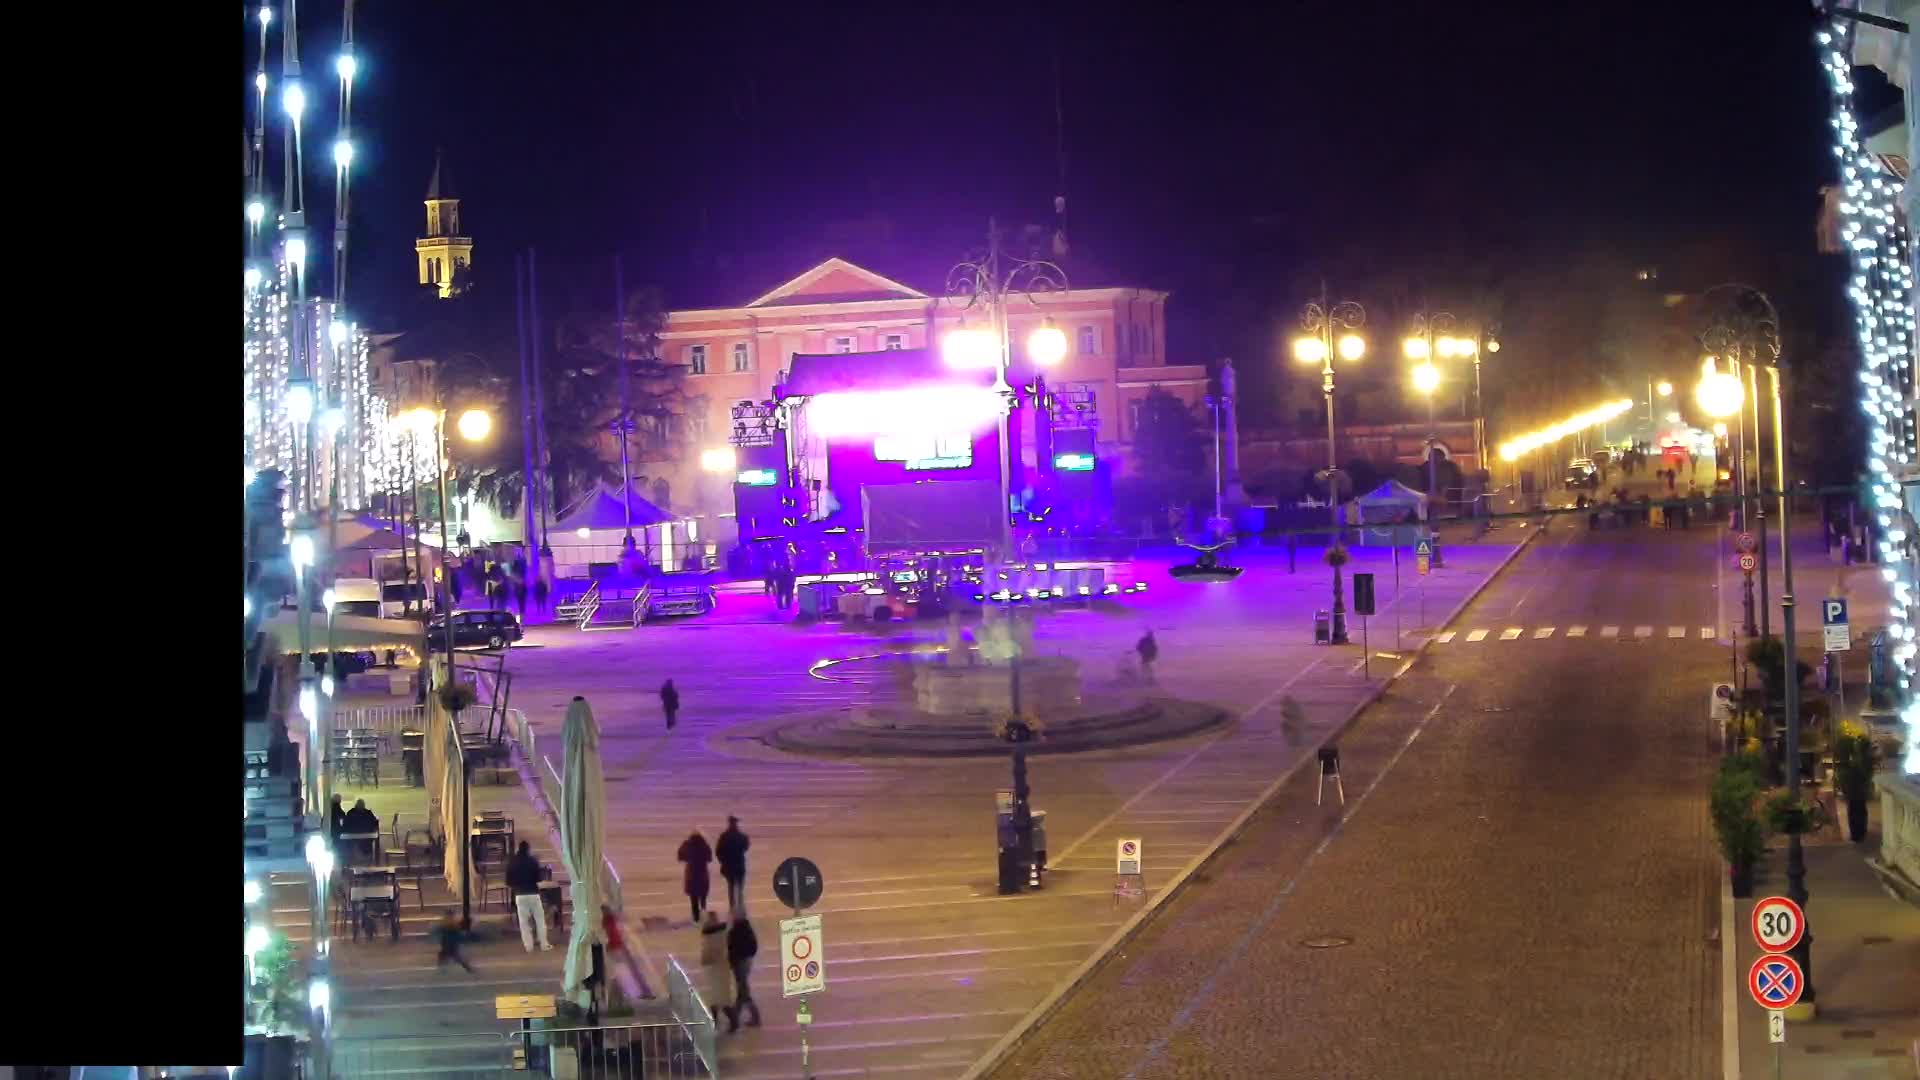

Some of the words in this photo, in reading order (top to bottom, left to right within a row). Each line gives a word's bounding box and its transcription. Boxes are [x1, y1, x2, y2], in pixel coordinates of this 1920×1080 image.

[1742, 558, 1753, 567] 20
[1828, 602, 1842, 622] P
[1763, 912, 1791, 937] 30
